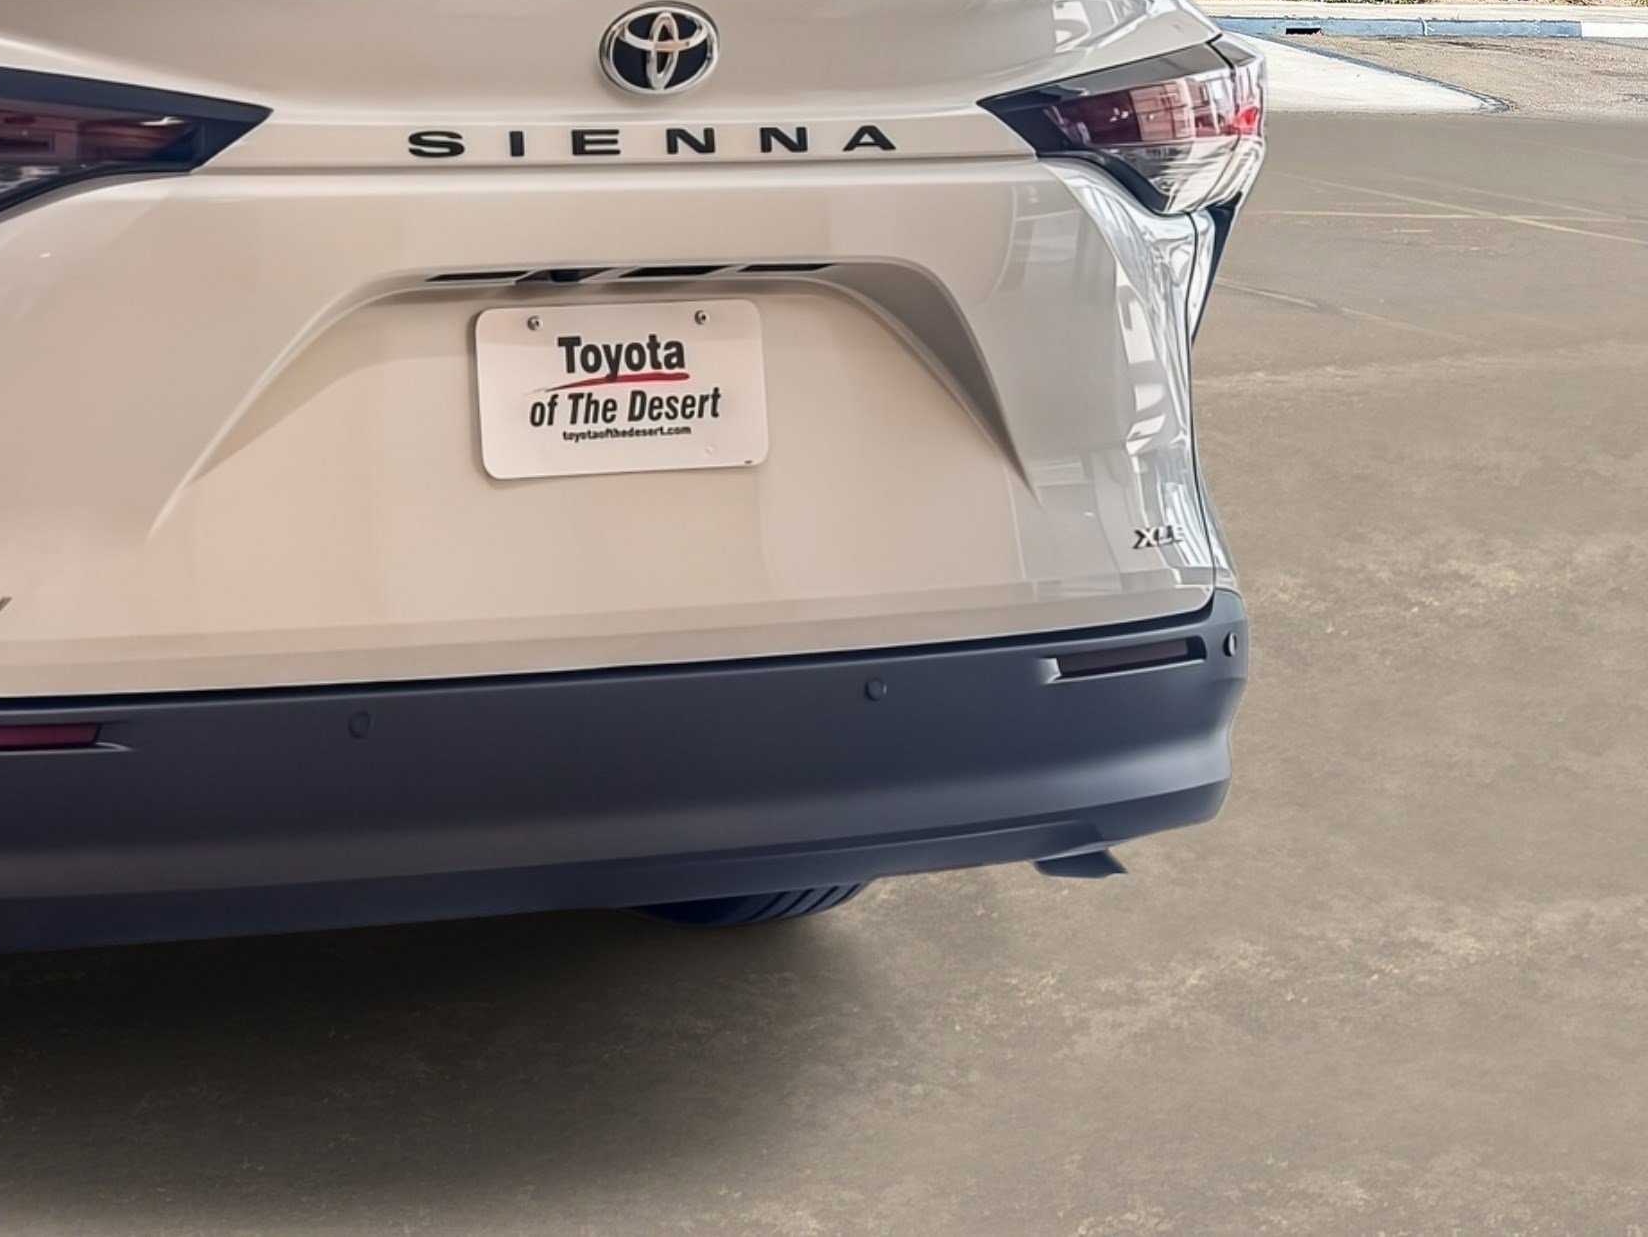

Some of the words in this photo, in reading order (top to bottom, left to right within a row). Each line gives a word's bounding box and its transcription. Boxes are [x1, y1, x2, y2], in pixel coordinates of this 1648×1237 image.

[408, 125, 897, 158] SIENNA
[557, 334, 686, 382] Toyota
[529, 394, 559, 427] of
[567, 392, 618, 425] The
[628, 386, 722, 422] Desert
[562, 426, 692, 443] toyotaofthedesert.com
